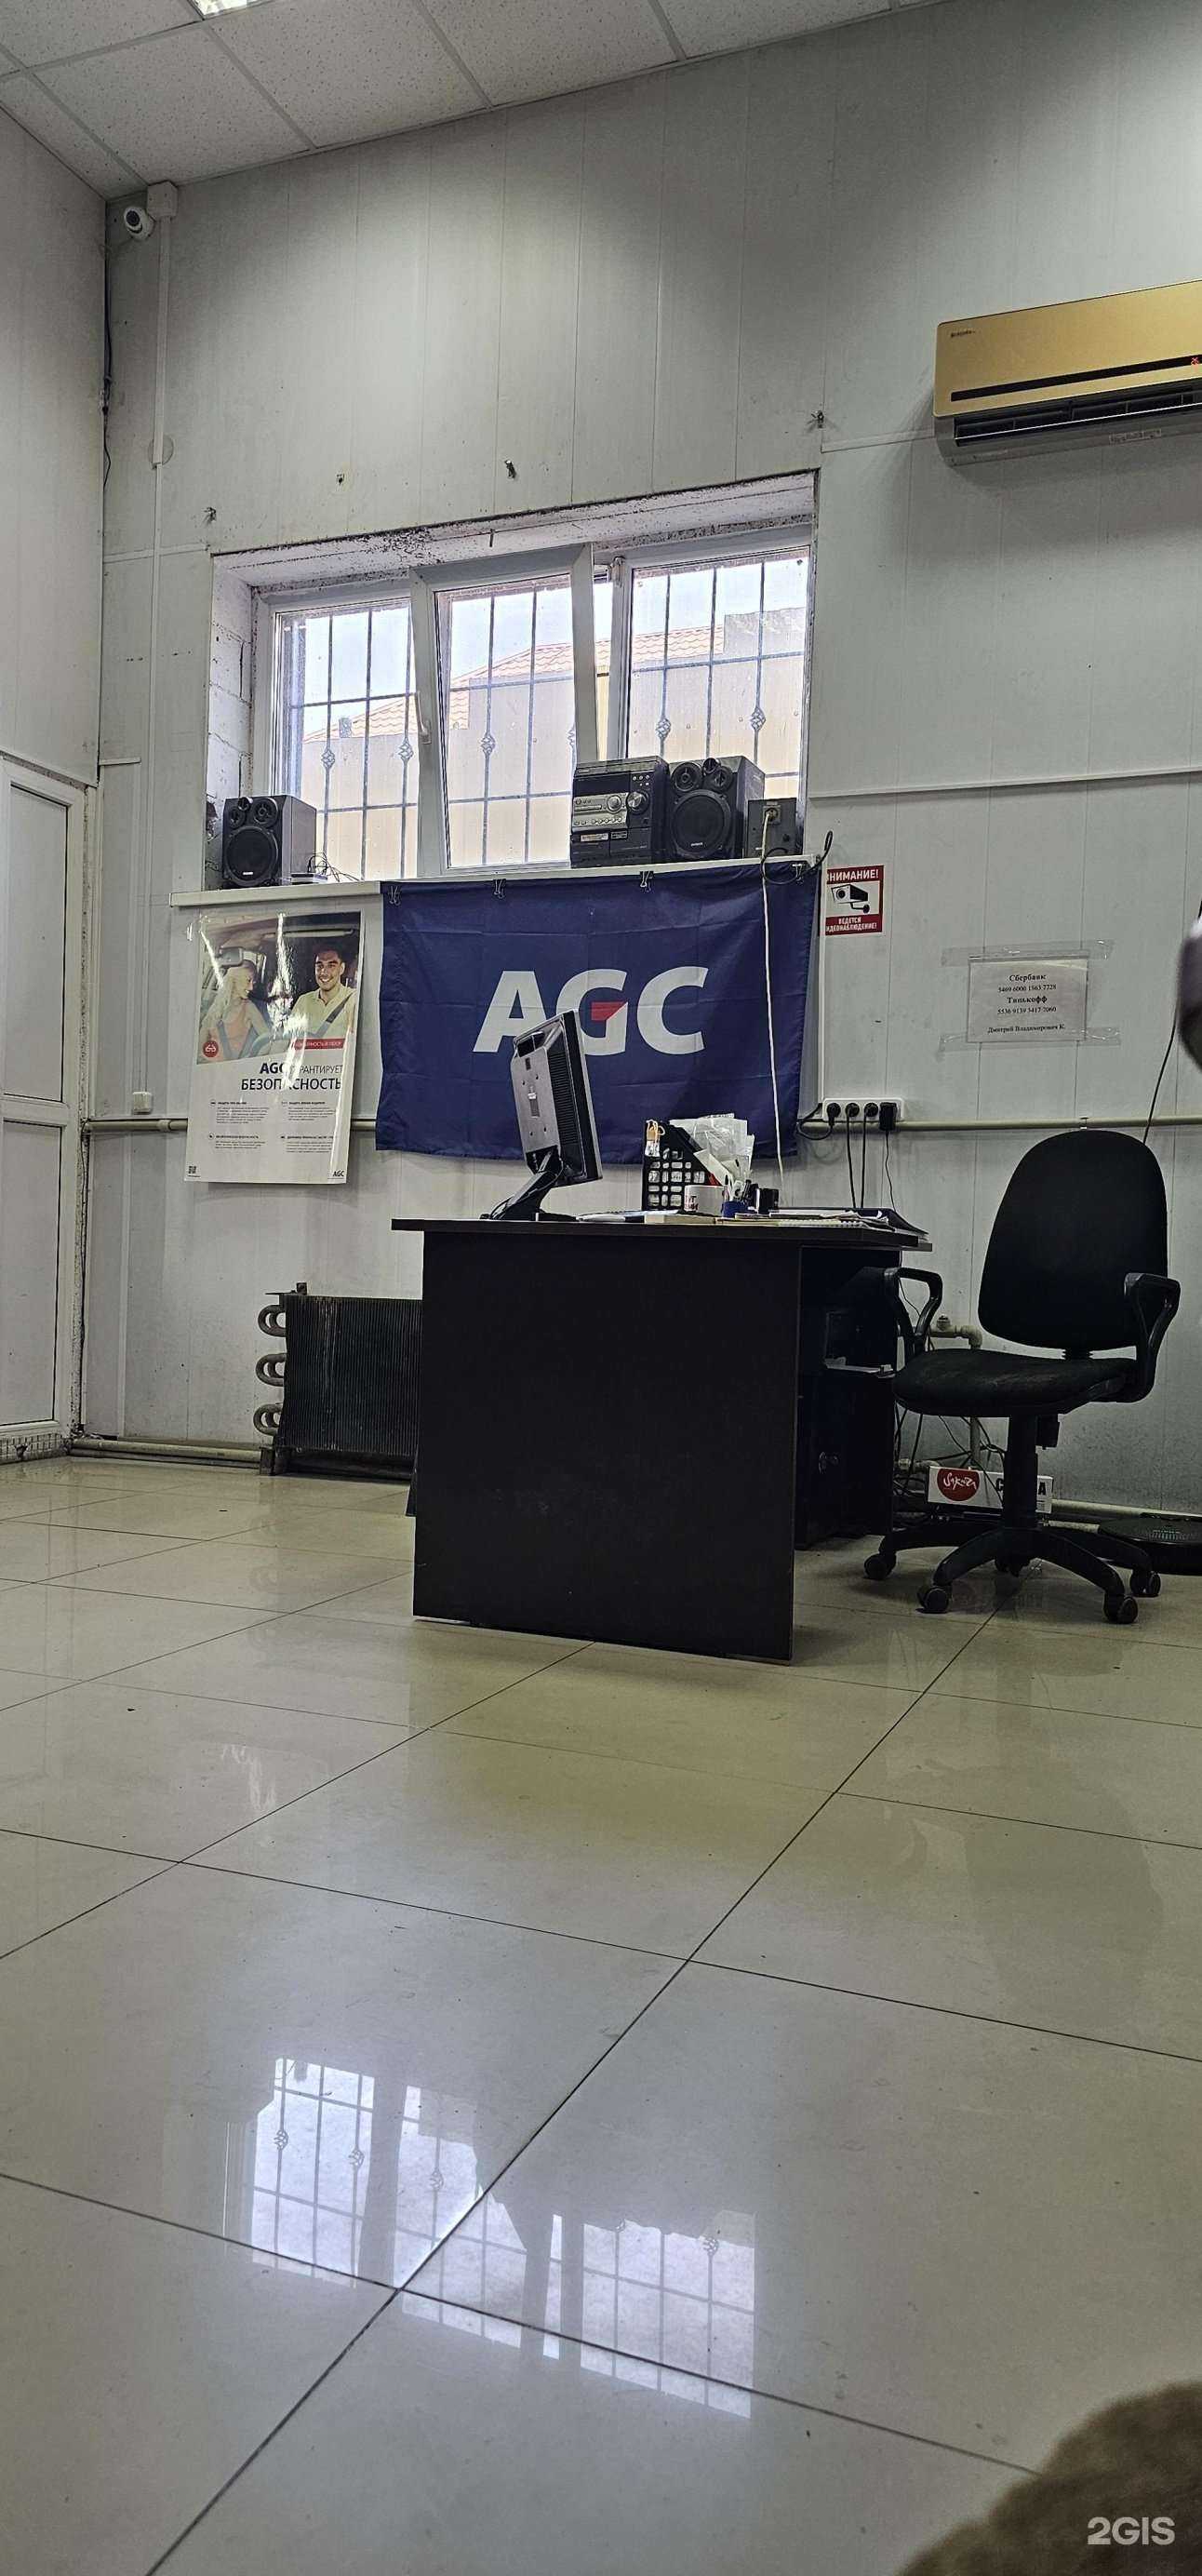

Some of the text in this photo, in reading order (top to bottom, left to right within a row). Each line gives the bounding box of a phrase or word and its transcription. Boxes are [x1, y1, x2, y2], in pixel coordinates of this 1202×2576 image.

[827, 868, 878, 882] НИМАНИЕ!
[1008, 973, 1047, 983] Сбербанк
[473, 966, 708, 1056] AGC
[241, 1078, 342, 1091] БЕЗОПСНОСТЬ
